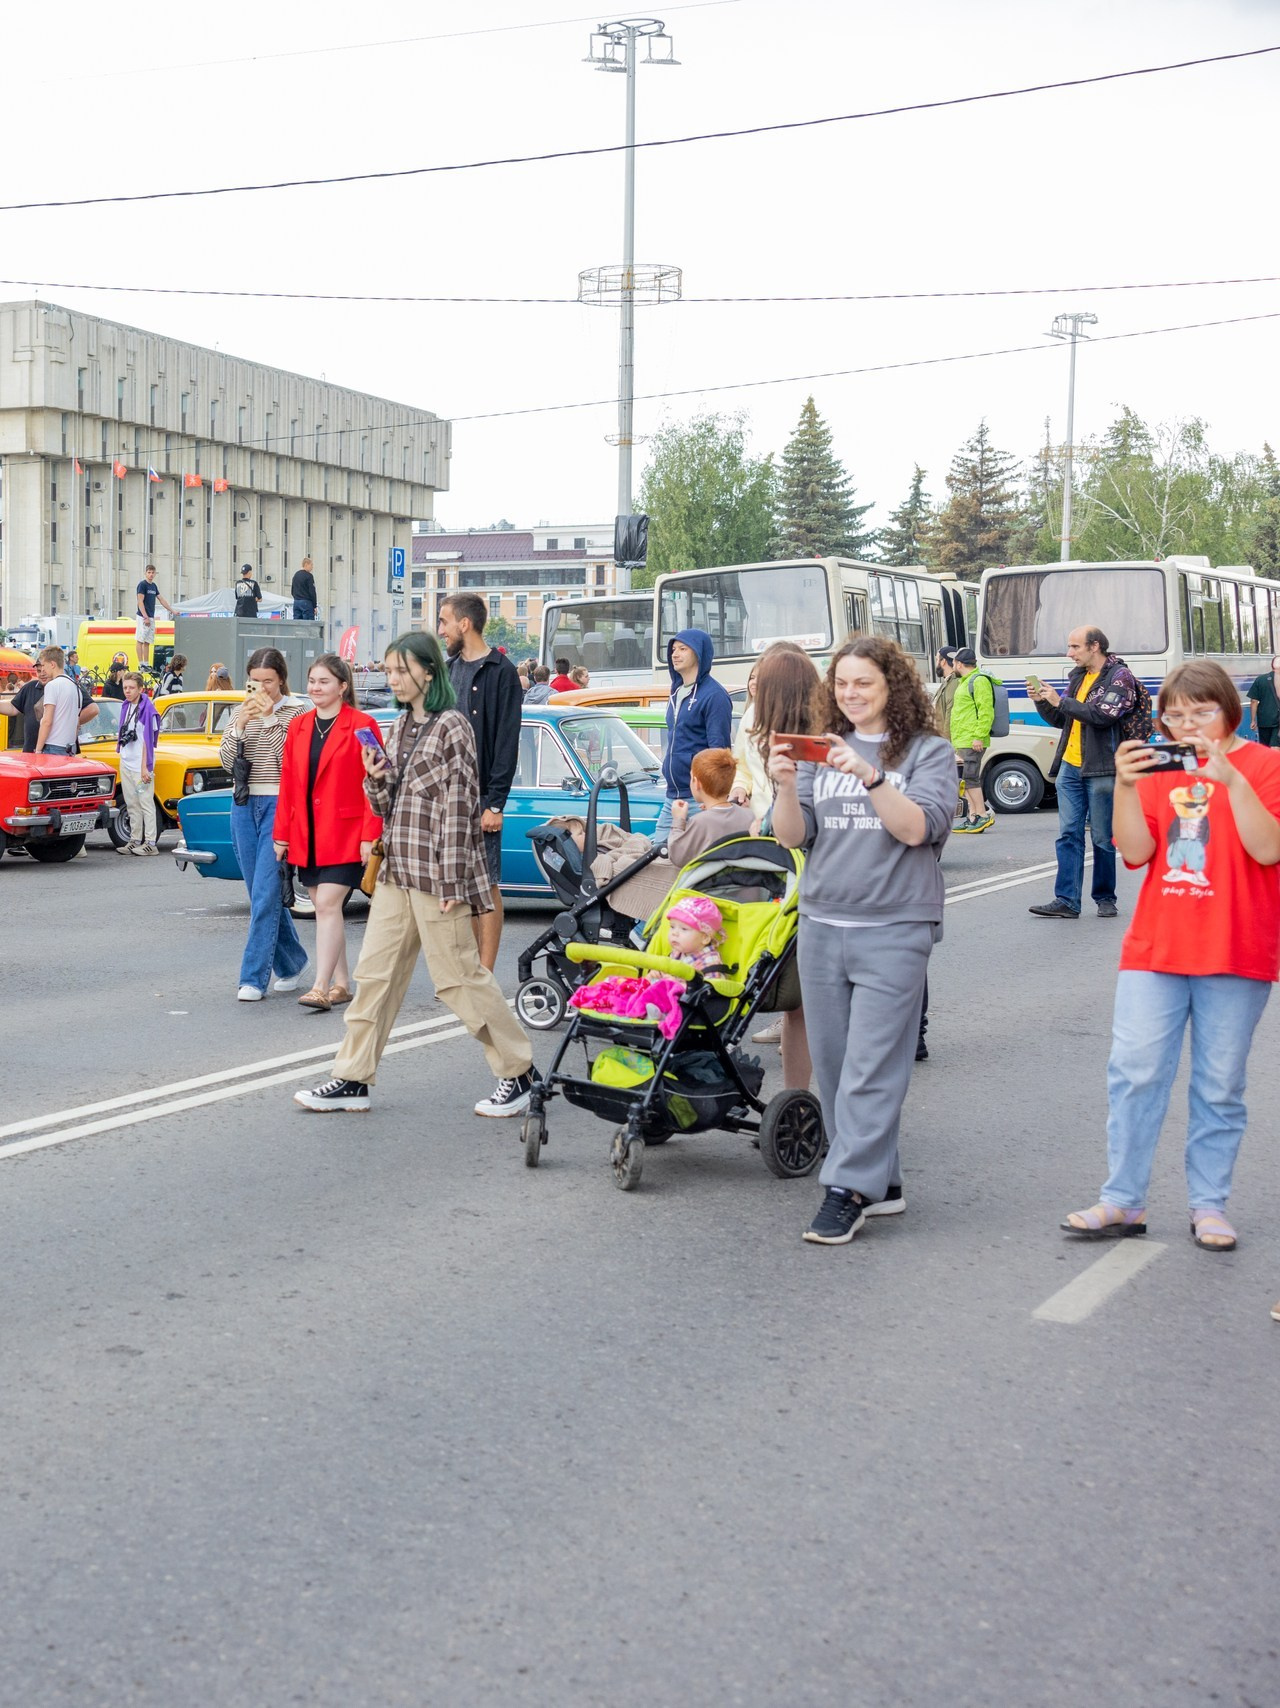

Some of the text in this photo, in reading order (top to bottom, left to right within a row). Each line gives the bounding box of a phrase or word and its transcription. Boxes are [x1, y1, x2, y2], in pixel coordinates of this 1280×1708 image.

[842, 803, 866, 815] USA
[824, 817, 882, 829] NEW YORK
